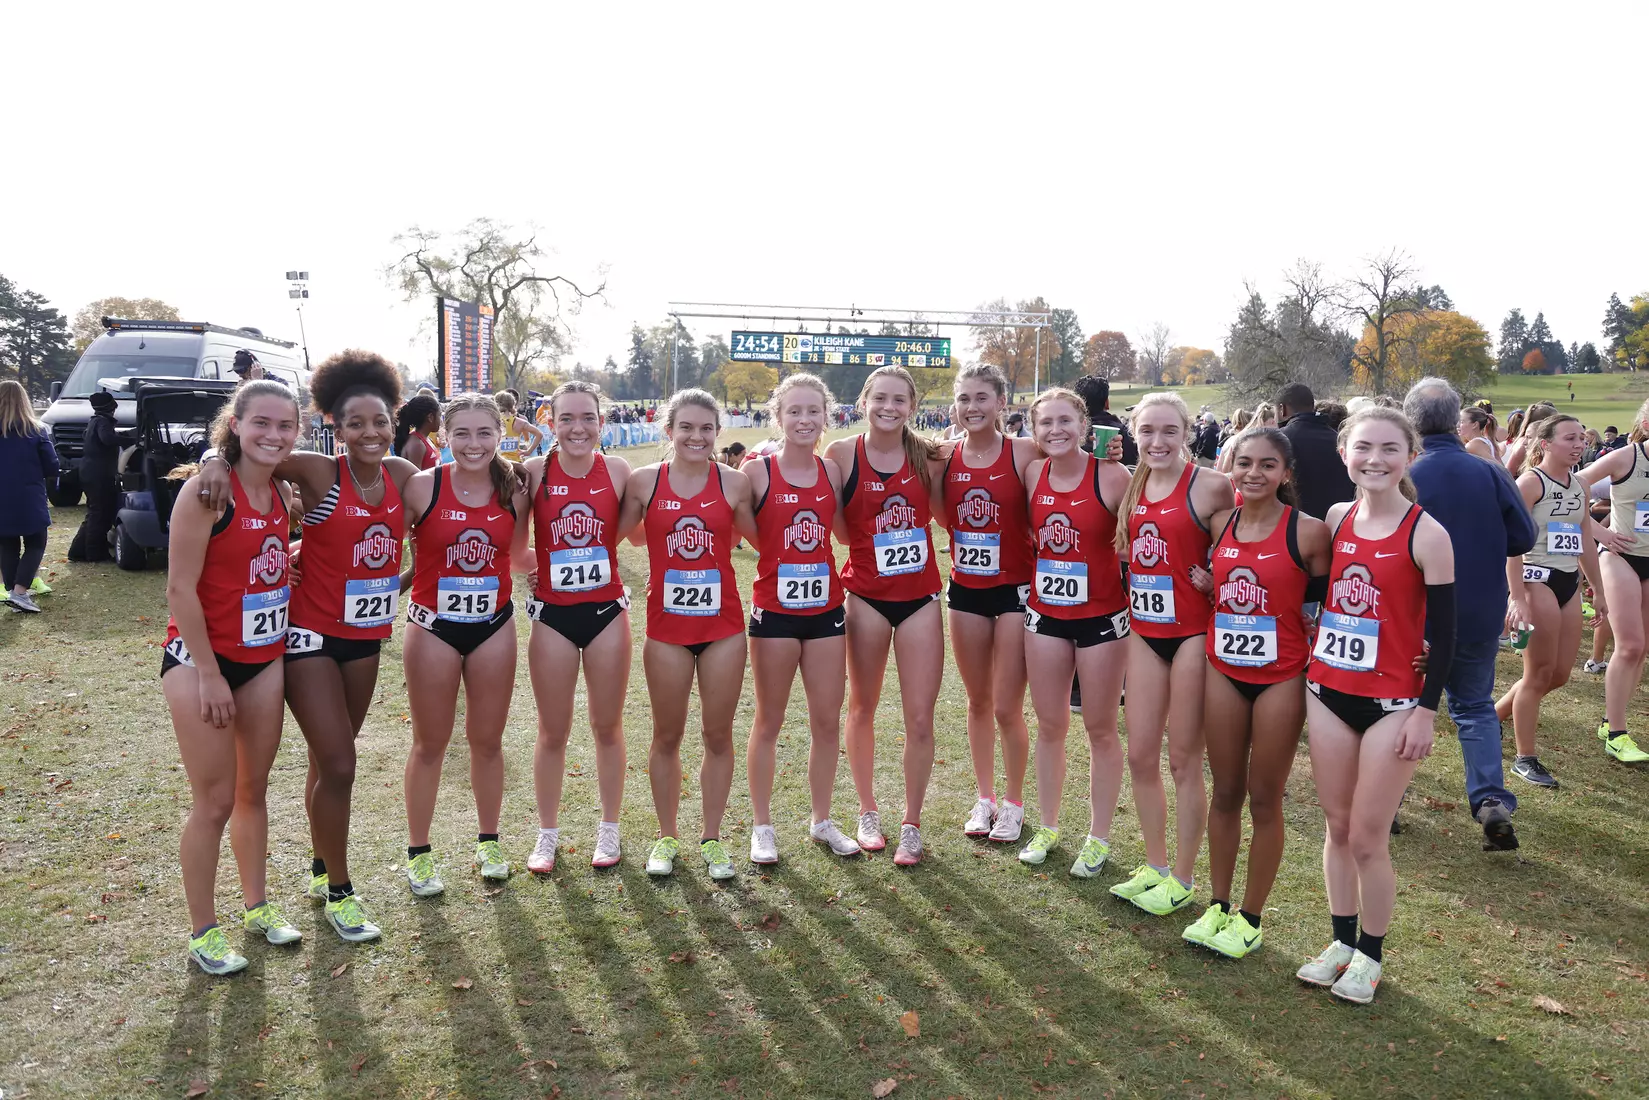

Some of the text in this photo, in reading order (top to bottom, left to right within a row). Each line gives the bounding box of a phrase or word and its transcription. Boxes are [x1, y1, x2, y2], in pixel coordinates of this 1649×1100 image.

[736, 335, 779, 352] 24:54
[785, 337, 798, 349] 20
[844, 338, 865, 347] KANE
[895, 341, 931, 353] 20:46.0
[808, 353, 818, 362] 78
[849, 355, 860, 364] 86
[931, 357, 945, 366] 104
[893, 505, 916, 529] STATE
[975, 498, 1000, 525] STATE
[574, 514, 604, 544] STATE
[803, 521, 825, 548] STATE
[1055, 523, 1080, 552] STATE
[374, 536, 397, 563] STATE
[687, 527, 714, 556] STATE
[1146, 534, 1169, 565] STATE
[1554, 534, 1579, 550] 239
[269, 548, 288, 578] STATE
[469, 540, 497, 568] STATE
[885, 545, 921, 567] 223
[959, 547, 991, 566] 225
[560, 564, 601, 586] 214
[673, 587, 712, 606] 224
[786, 579, 822, 599] 216
[1043, 576, 1078, 597] 220
[1238, 579, 1268, 613] STATE
[1351, 578, 1380, 617] STATE
[355, 595, 392, 618] 221
[448, 594, 489, 613] 215
[1132, 591, 1164, 613] 218
[254, 607, 287, 635] 217
[409, 604, 429, 623] 15
[1223, 633, 1265, 656] 222
[1323, 633, 1365, 662] 219
